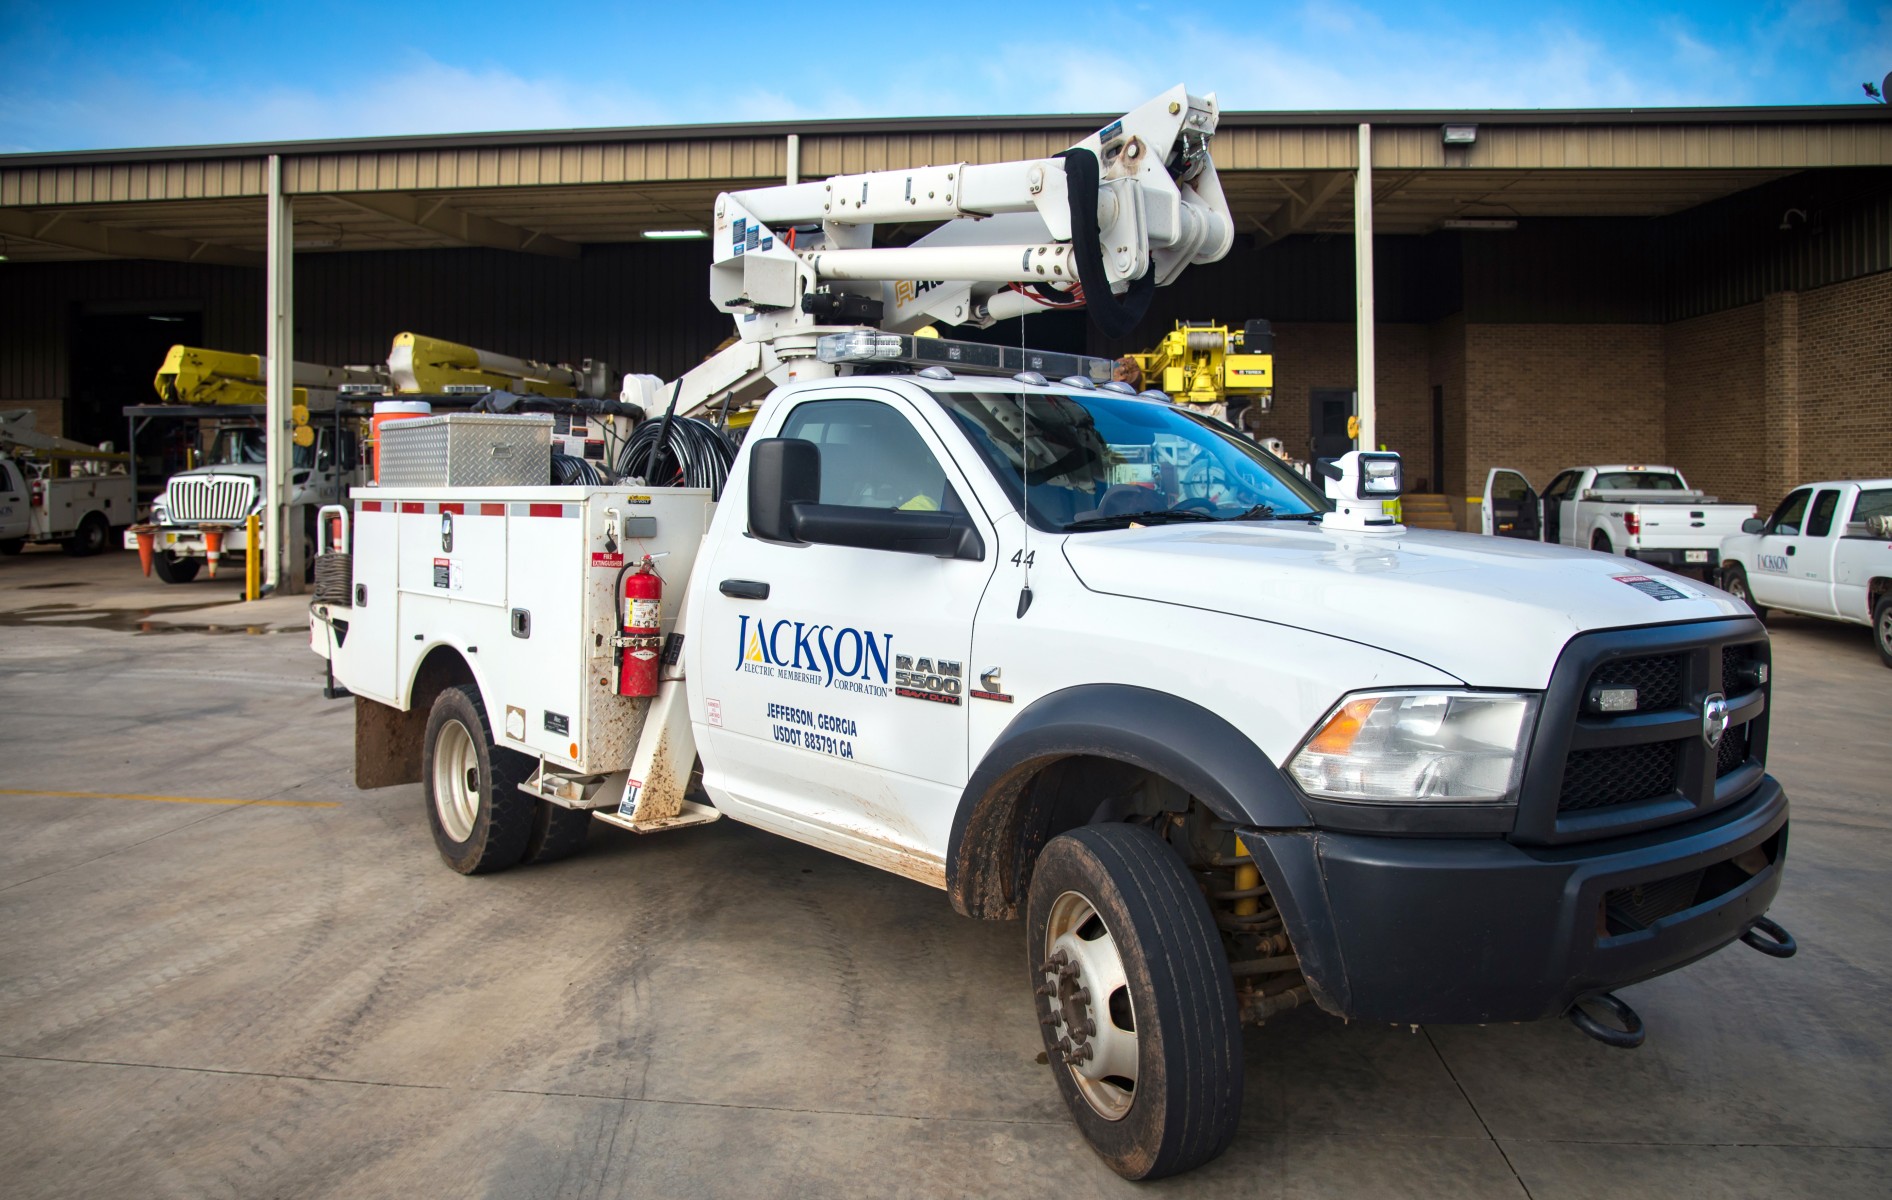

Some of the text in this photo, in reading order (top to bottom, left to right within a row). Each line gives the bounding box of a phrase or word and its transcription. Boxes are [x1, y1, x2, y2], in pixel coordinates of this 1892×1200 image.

[1010, 549, 1036, 569] 44
[735, 614, 894, 688] JACKSON
[895, 653, 962, 678] RAM
[744, 662, 888, 698] ELECTRIC MEMBERSHIP CORPORATION
[895, 670, 962, 695] 5500
[896, 688, 957, 704] HEAVY DUTY
[971, 691, 989, 699] TURBO
[766, 702, 858, 737] JEFFERSON, GEORGIA
[772, 724, 854, 760] USDOT 883791 GA
